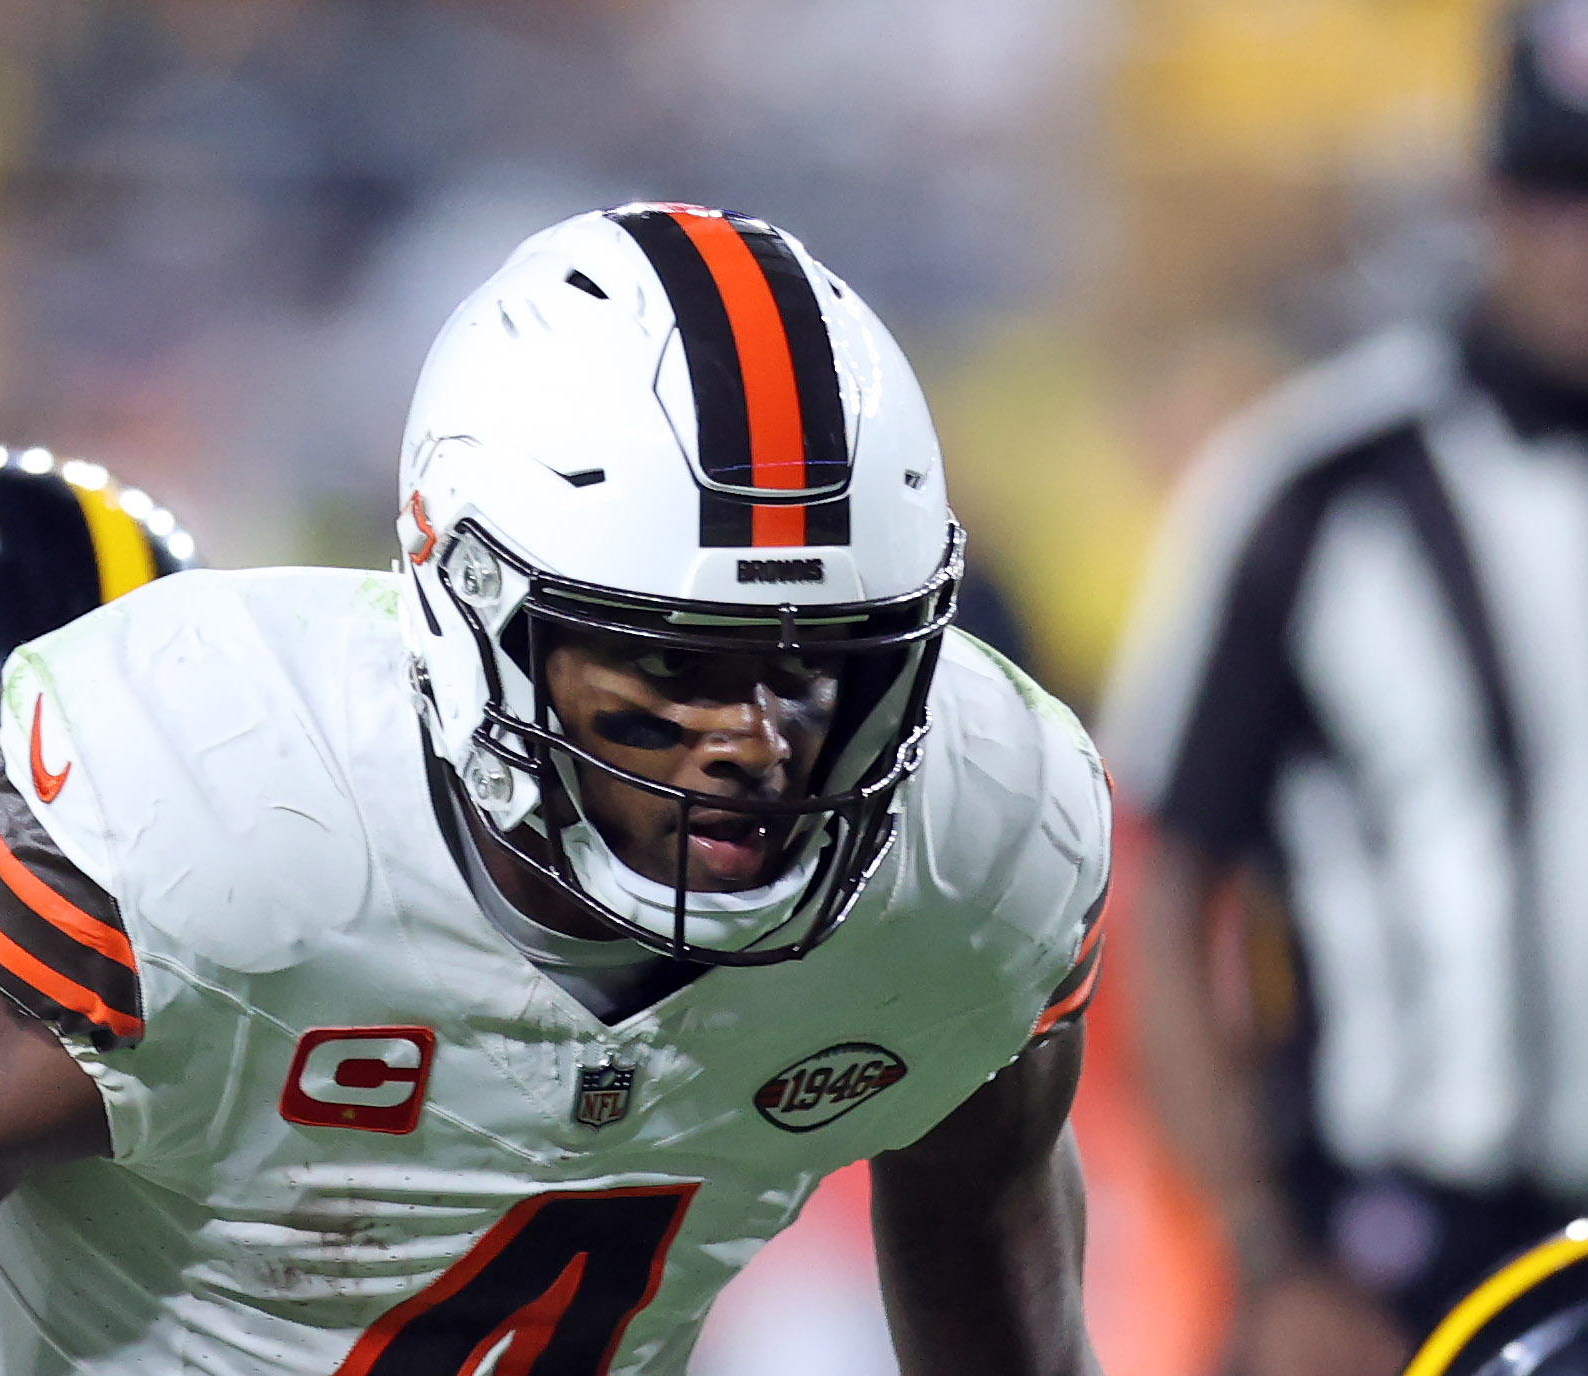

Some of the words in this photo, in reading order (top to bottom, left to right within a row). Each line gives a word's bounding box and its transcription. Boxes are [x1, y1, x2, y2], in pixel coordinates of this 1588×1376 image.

[738, 558, 824, 583] BROWNS
[299, 1038, 421, 1107] C
[780, 1060, 885, 1112] 1946
[582, 1092, 624, 1120] NFL
